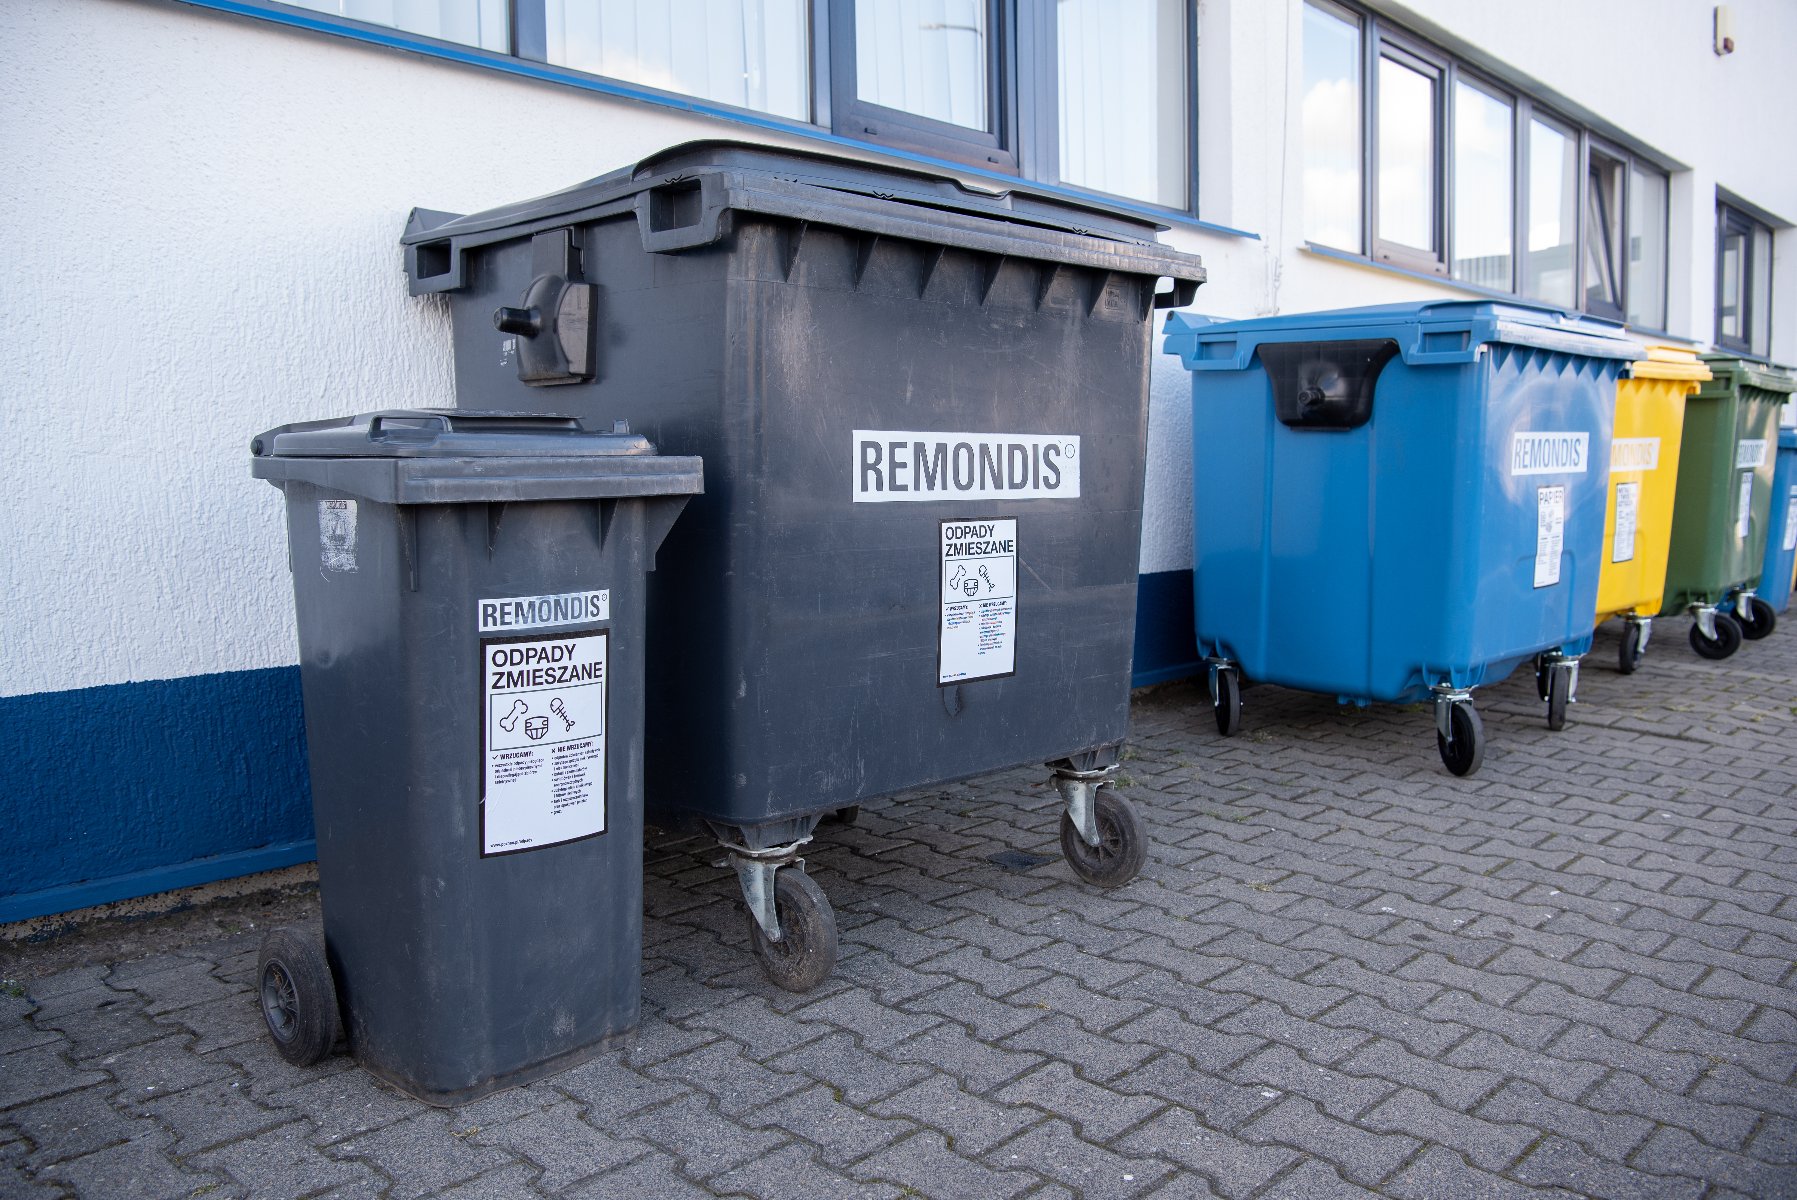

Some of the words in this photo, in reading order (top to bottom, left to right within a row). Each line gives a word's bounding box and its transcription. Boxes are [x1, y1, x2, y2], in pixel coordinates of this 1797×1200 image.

[1513, 438, 1581, 469] REMONDIS
[1612, 443, 1653, 466] MONDIS
[860, 441, 1061, 492] REMONDIS
[1539, 490, 1563, 505] PAPIER
[945, 524, 995, 539] ODPADY
[945, 539, 1014, 557] ZMIESZANE
[482, 595, 600, 627] REMONDIS
[491, 644, 576, 668] ODPADY
[491, 661, 603, 690] ZMIESZANE
